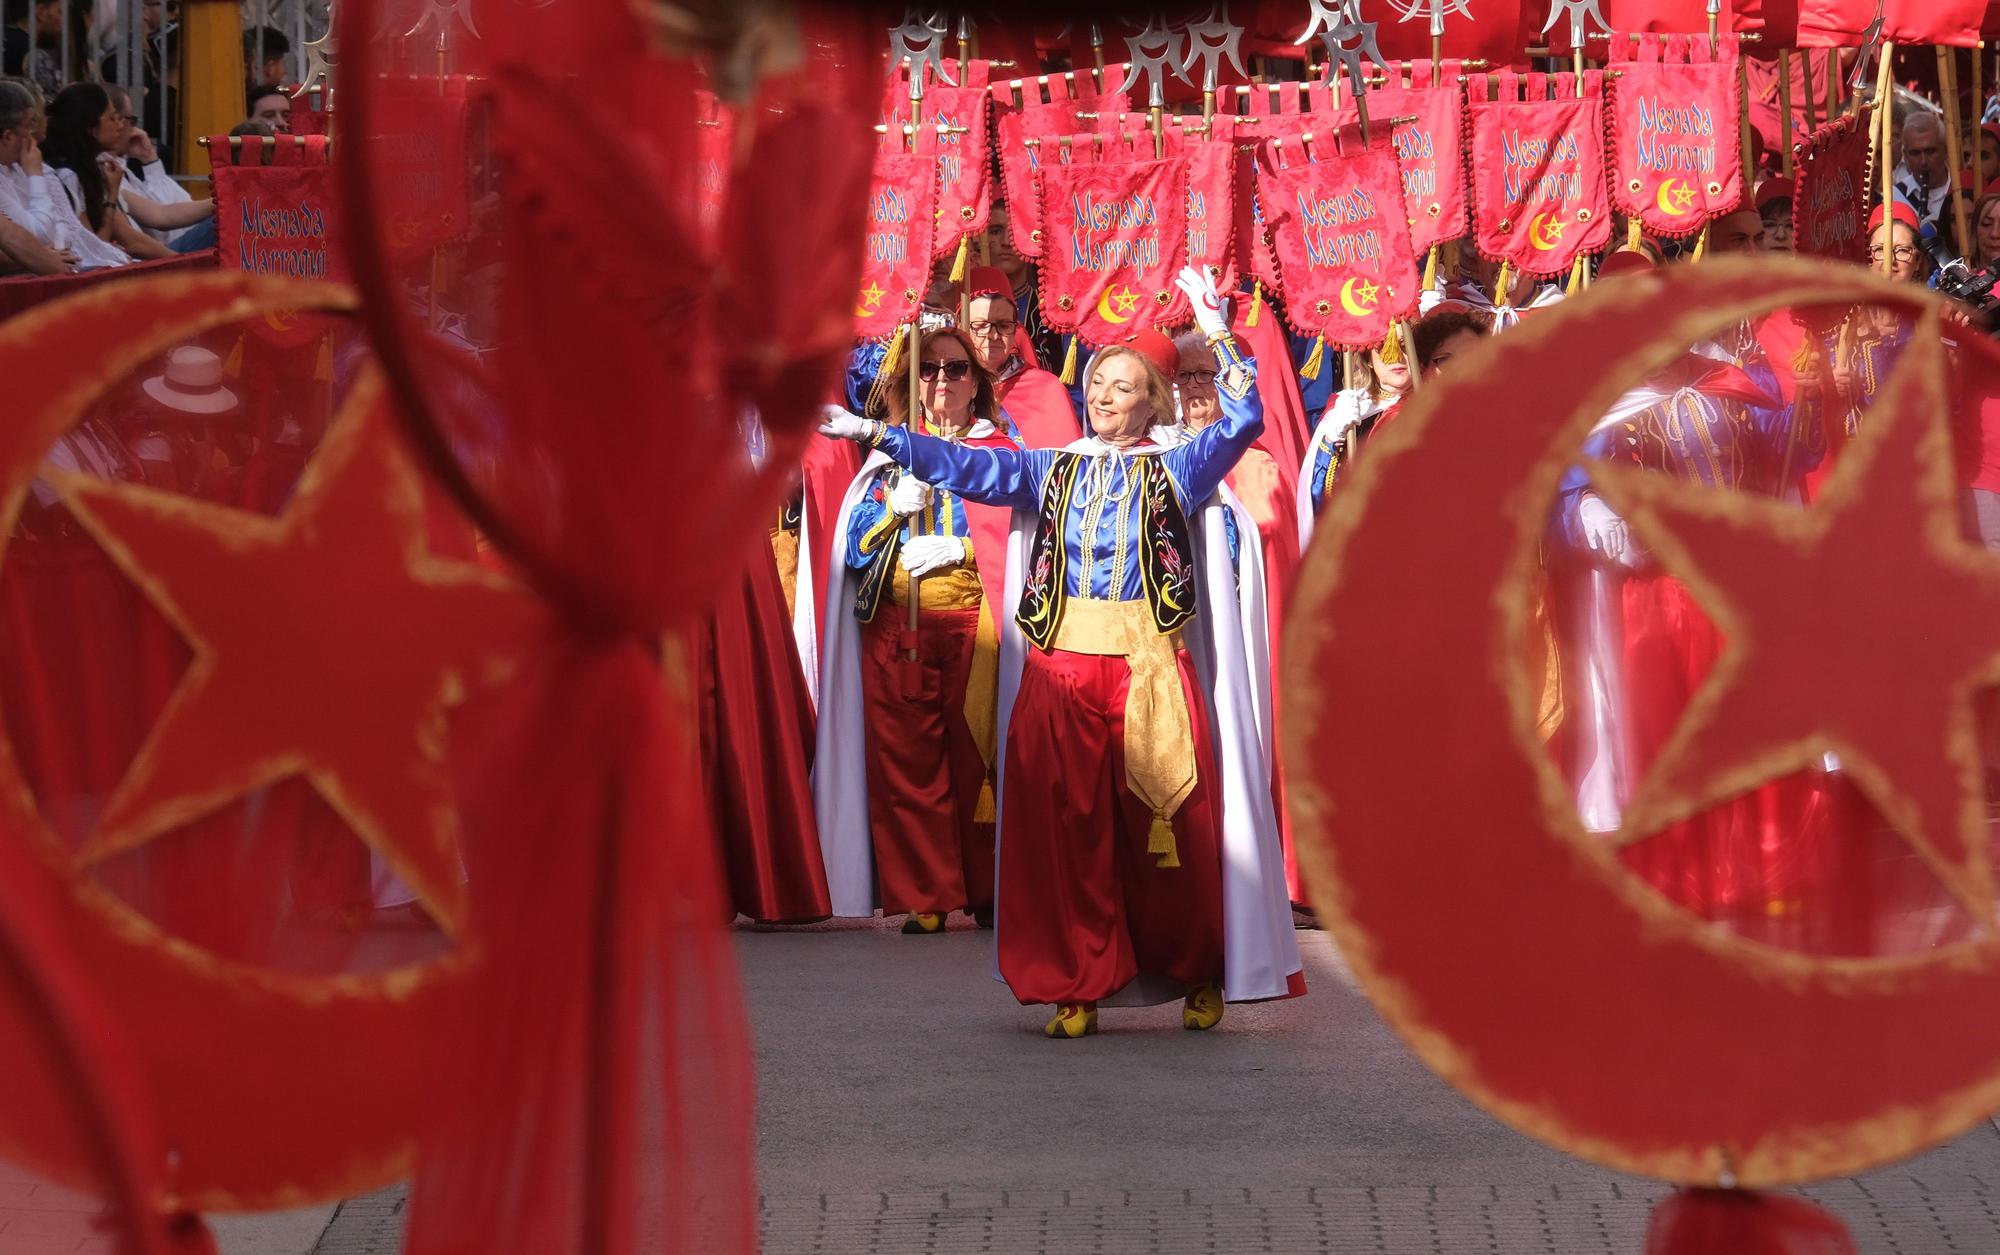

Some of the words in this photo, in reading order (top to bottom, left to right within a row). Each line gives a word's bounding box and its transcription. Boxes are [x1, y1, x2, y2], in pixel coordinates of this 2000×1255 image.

[1638, 95, 1713, 137] Mesnada
[1637, 133, 1715, 183] Marroqui
[241, 196, 326, 239] Mesnada
[1073, 189, 1157, 233] Mesnada
[240, 236, 327, 282] Marroqui
[1072, 228, 1160, 281] Marroqui
